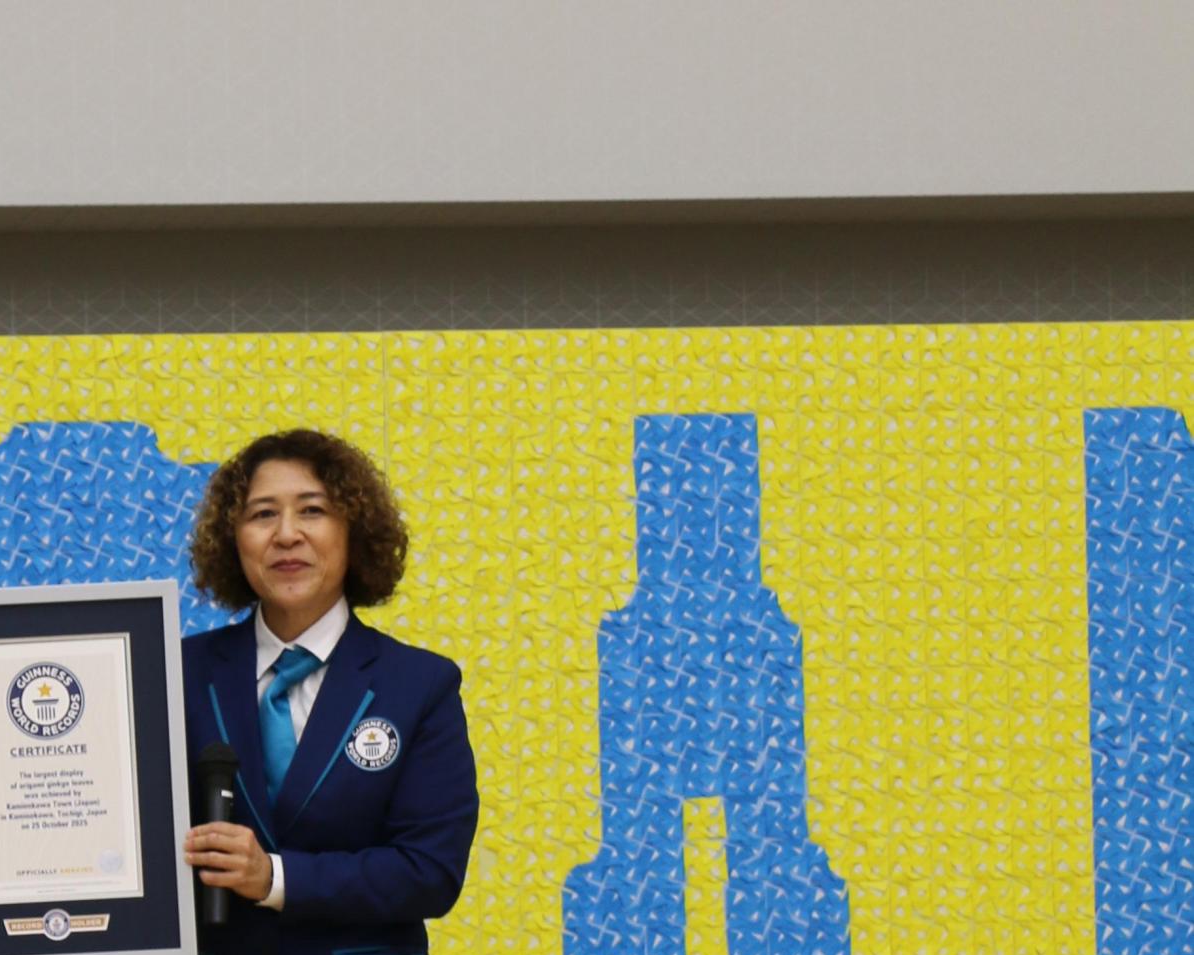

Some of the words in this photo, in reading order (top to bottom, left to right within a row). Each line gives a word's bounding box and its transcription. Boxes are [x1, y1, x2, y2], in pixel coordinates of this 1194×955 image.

[16, 666, 73, 689] GUINNESS
[11, 697, 39, 734] WORLD
[42, 693, 81, 736] RECORDS
[9, 744, 87, 758] CERTIFICATE
[19, 771, 32, 779] The
[34, 770, 58, 779] largest
[59, 769, 84, 778] display
[19, 782, 45, 790] origami
[47, 780, 70, 789] ginkgo
[41, 790, 71, 799] achieved
[73, 790, 81, 798] by
[53, 800, 72, 808] Town
[74, 798, 101, 808] (Japan)
[86, 808, 108, 817] Japan
[42, 820, 69, 829] October
